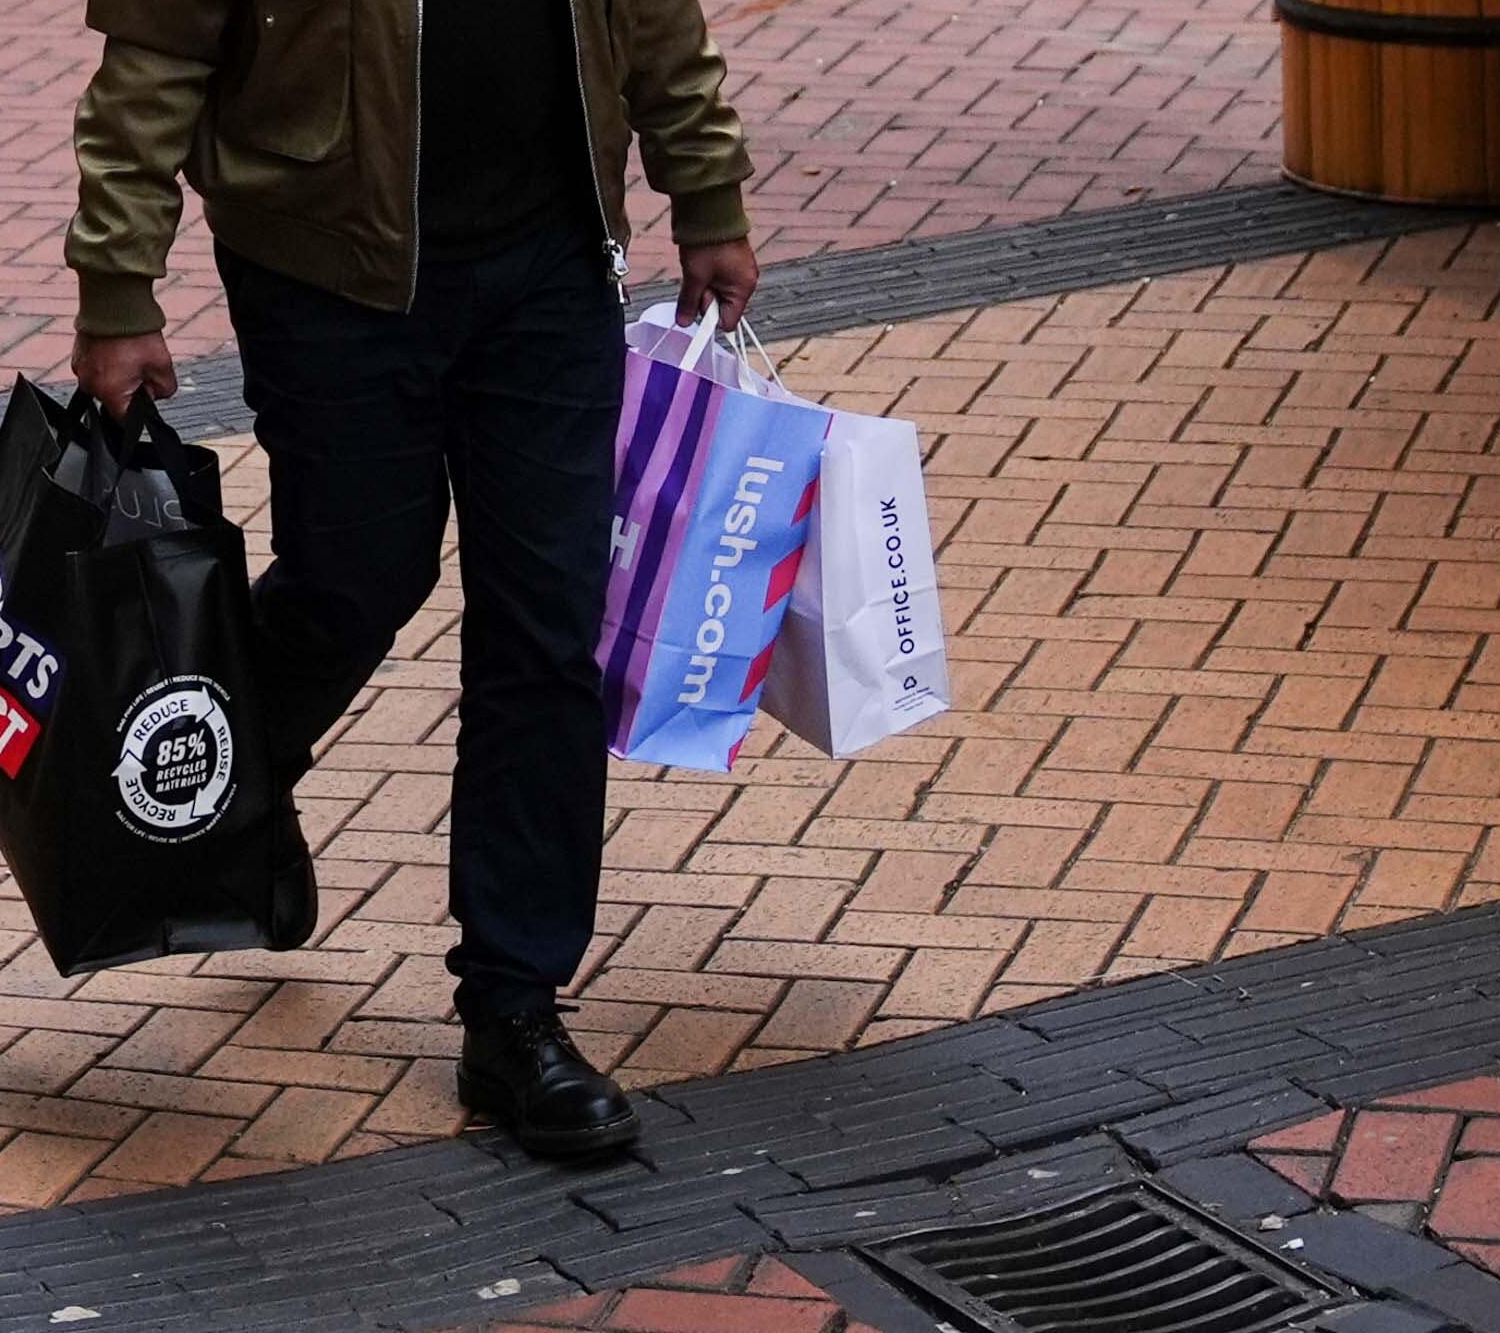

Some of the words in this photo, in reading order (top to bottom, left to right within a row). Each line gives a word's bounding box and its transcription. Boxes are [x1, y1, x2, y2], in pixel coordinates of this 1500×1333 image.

[676, 456, 785, 704] lush.com
[879, 496, 916, 655] OFFICE.CO.UK
[133, 698, 190, 742] REDUCE
[156, 728, 207, 767] 85%
[217, 725, 230, 782] REUSE
[155, 758, 208, 782] RECYCLED
[155, 772, 208, 794] MATERIALS
[125, 777, 177, 822] RECYCLE
